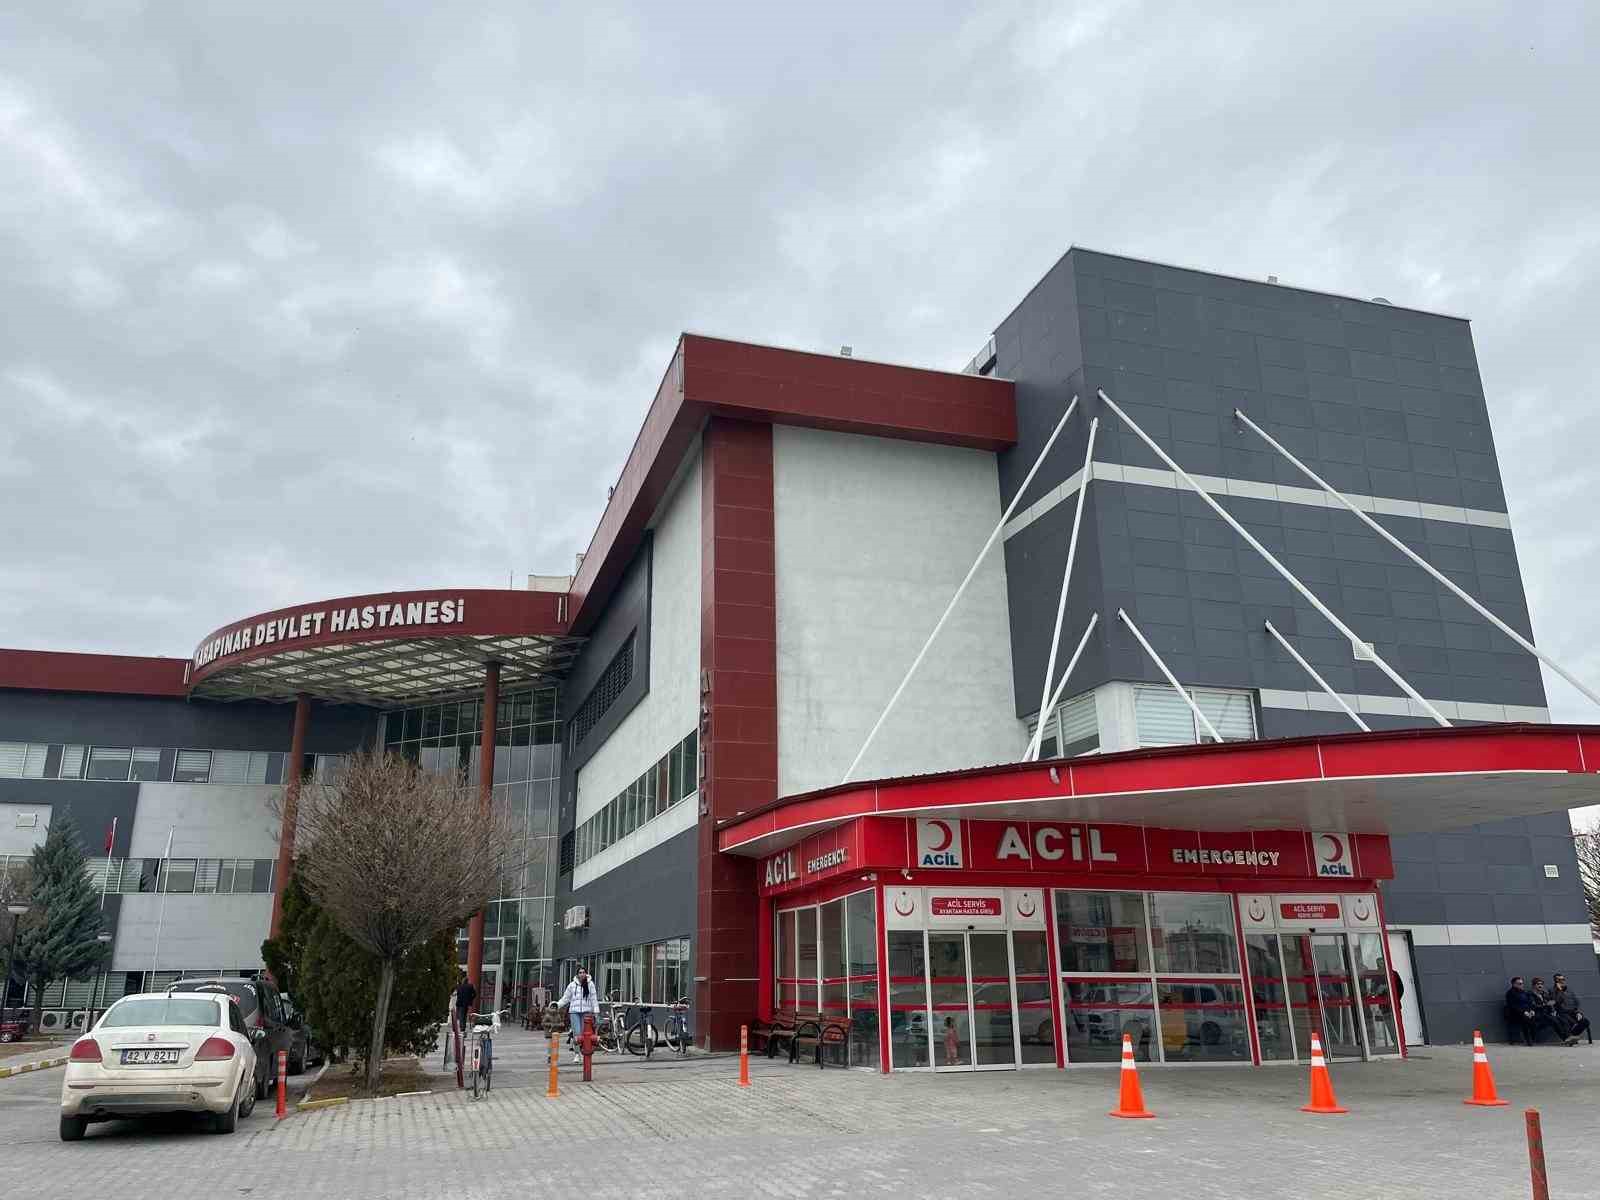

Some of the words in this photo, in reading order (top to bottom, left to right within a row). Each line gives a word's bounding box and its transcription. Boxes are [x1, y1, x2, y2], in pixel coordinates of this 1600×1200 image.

[255, 611, 326, 646] DEVLET
[807, 848, 846, 874] EMERGENCY
[922, 851, 959, 866] ACİL
[1172, 847, 1280, 866] EMERGENCY
[127, 1051, 139, 1060] 42
[144, 1051, 149, 1060] V
[153, 1050, 177, 1060] 8211
